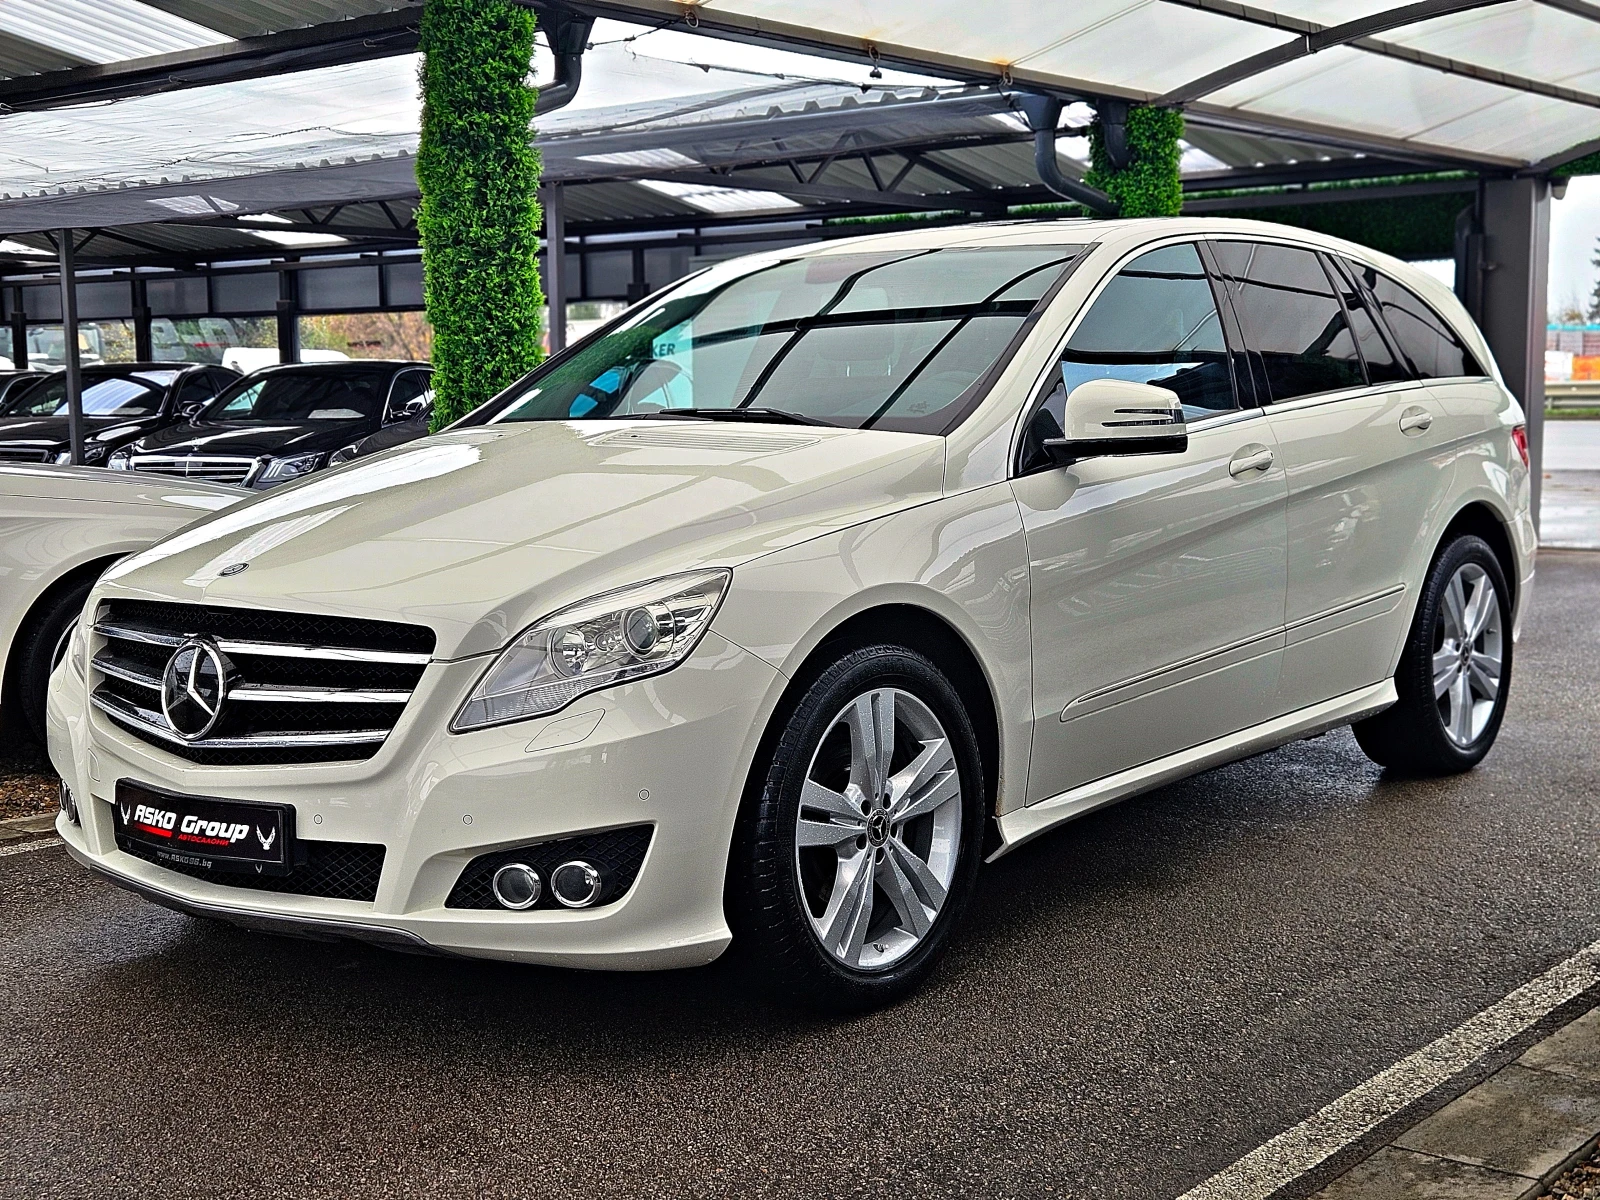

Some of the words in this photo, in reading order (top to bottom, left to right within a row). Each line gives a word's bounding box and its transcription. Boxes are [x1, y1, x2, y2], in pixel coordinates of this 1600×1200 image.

[133, 804, 177, 830] ASKO
[180, 815, 250, 843] Group
[178, 833, 230, 847] АВТОСАЛОНИ
